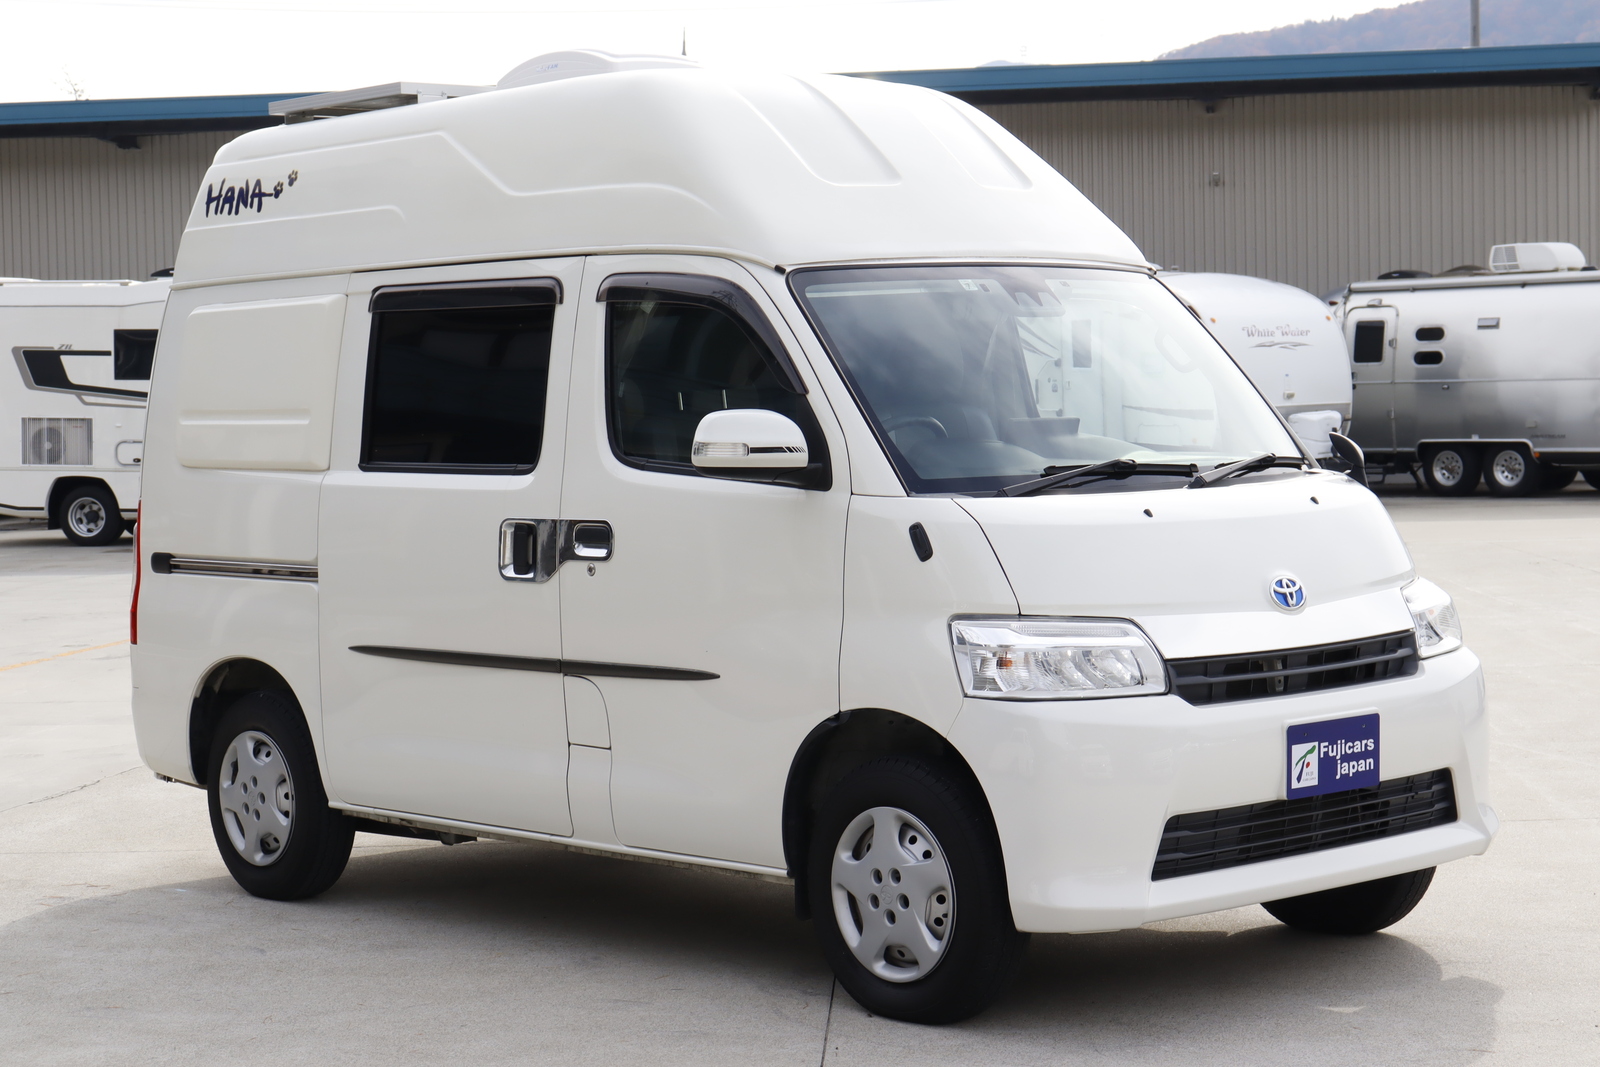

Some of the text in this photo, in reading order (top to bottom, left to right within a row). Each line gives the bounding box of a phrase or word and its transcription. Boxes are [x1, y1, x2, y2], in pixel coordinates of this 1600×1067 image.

[205, 178, 273, 218] HANA
[1242, 323, 1311, 337] White Water
[1320, 738, 1375, 760] Fujicars
[1335, 757, 1374, 780] japan
